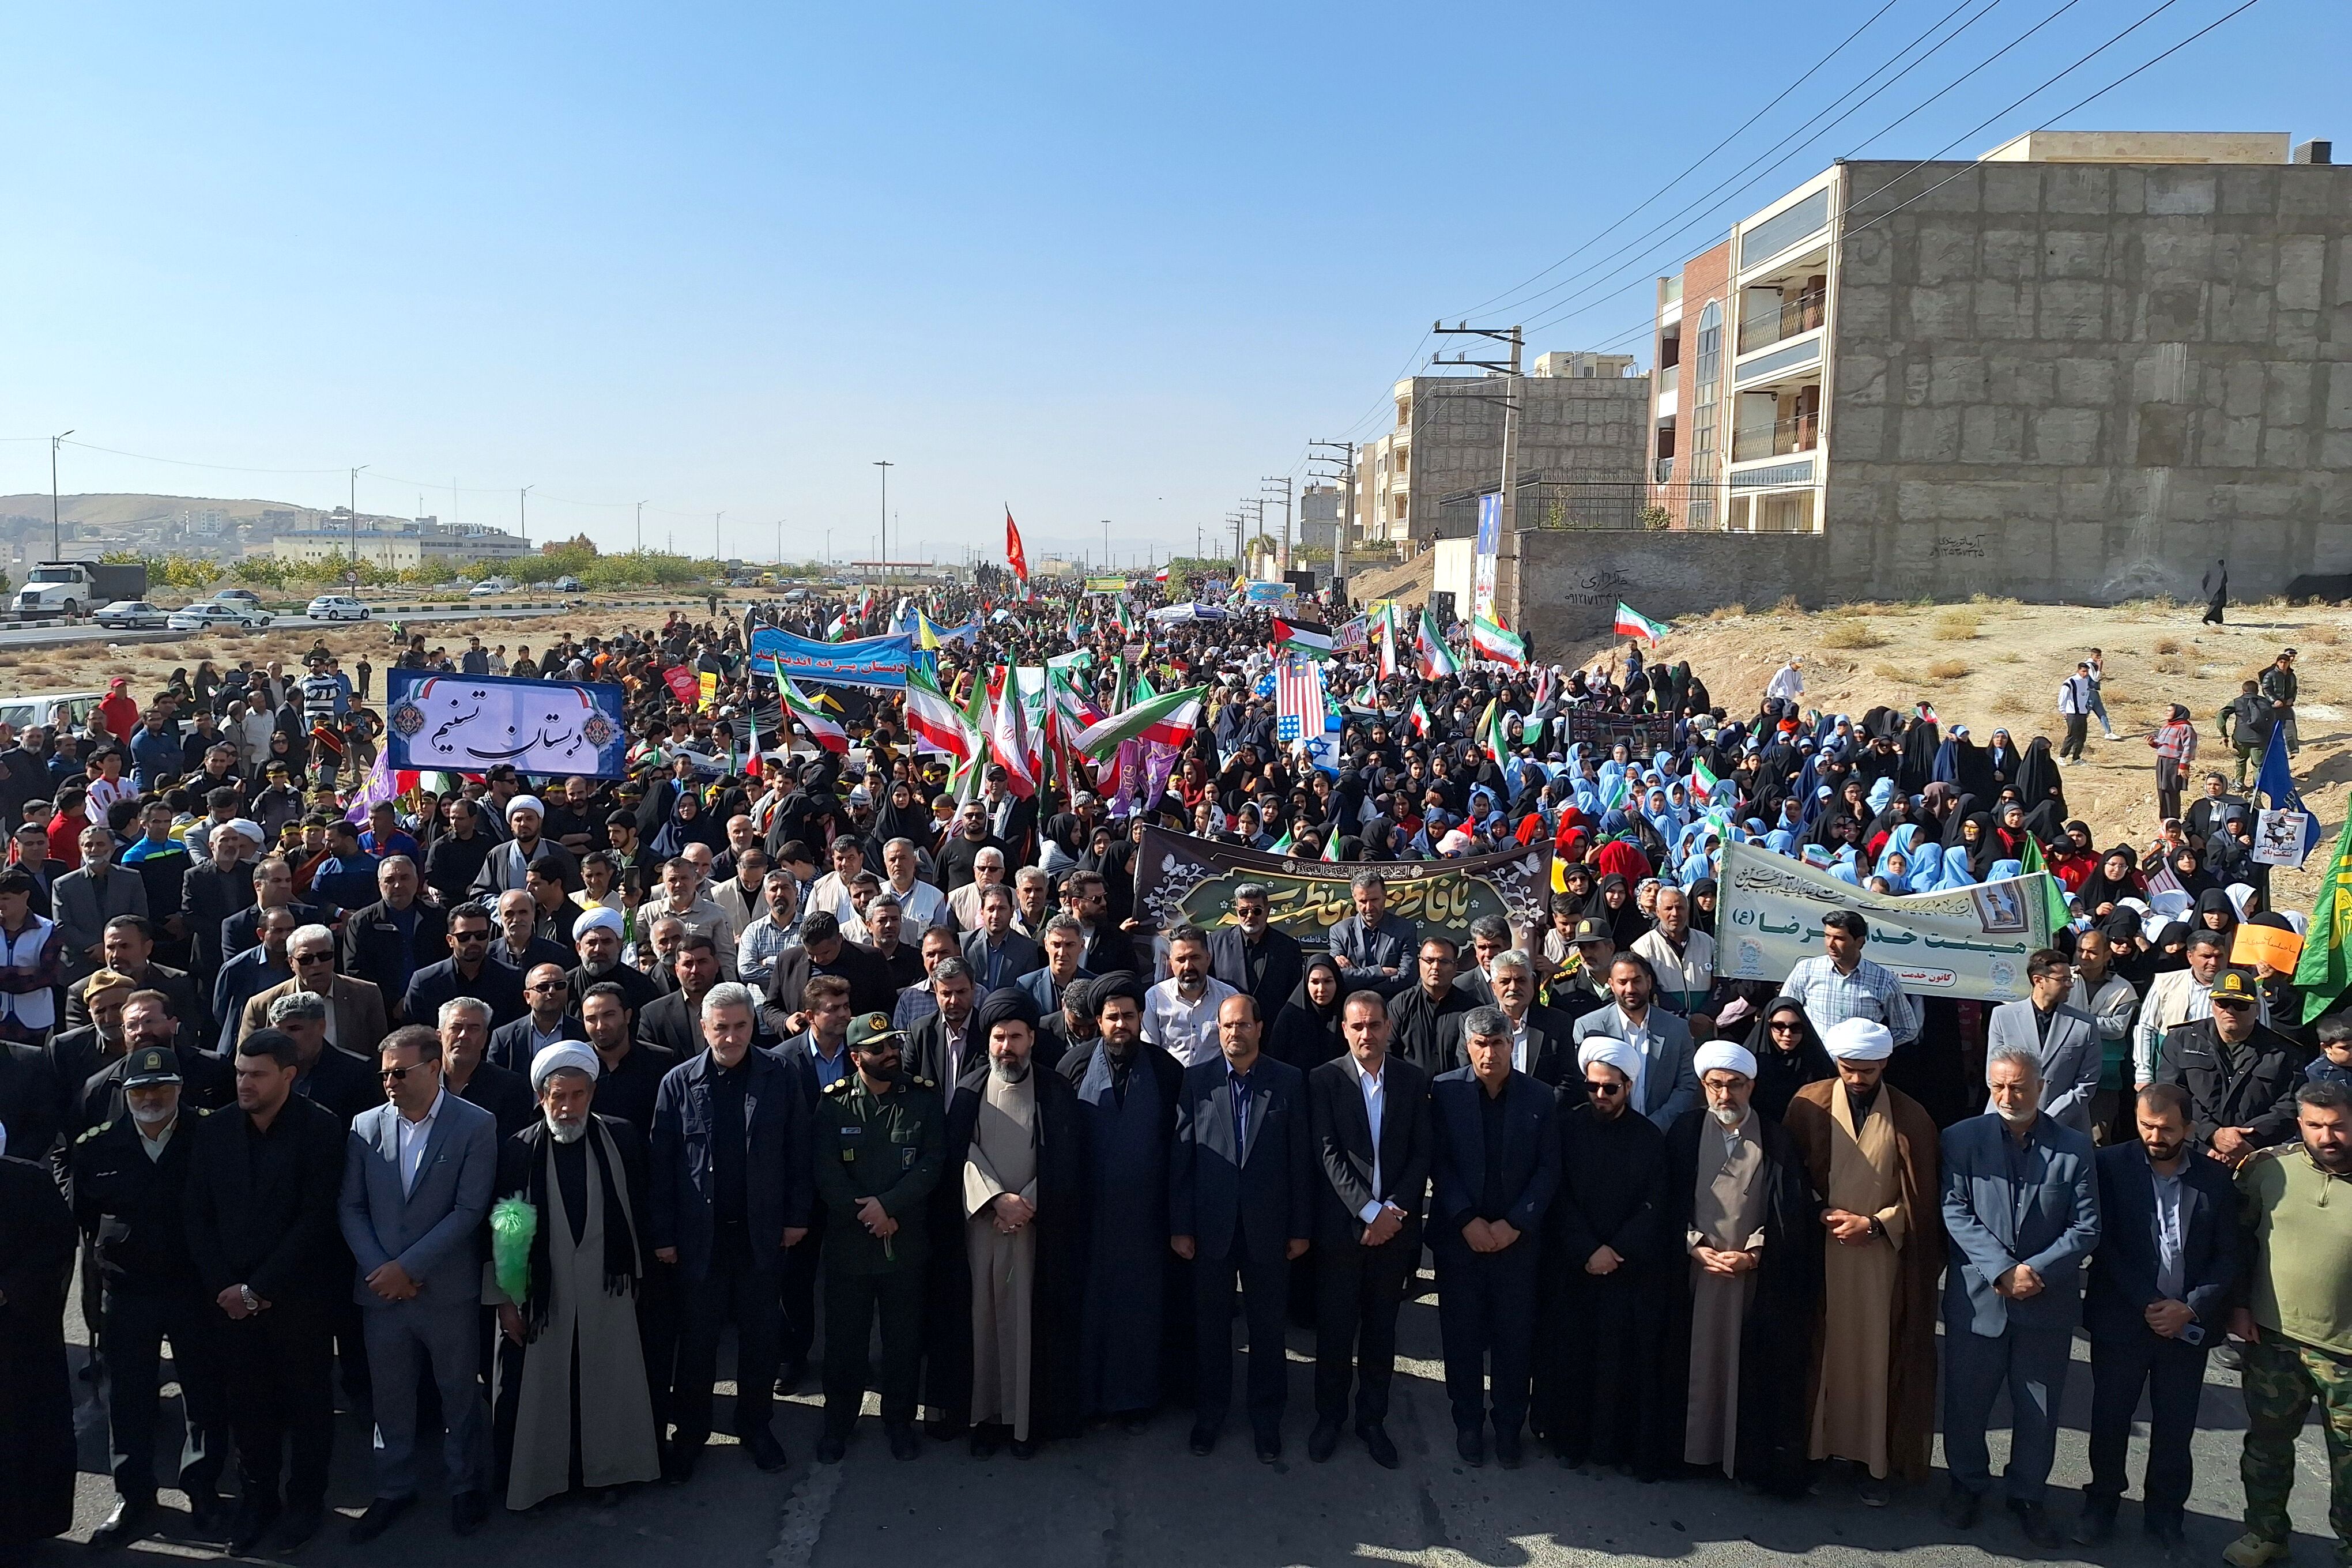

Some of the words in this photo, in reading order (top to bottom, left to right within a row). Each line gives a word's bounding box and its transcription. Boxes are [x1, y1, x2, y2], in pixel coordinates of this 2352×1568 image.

[861, 659, 907, 676] دبستان
[431, 689, 488, 753] تسنیم
[465, 713, 583, 760] دبستان
[1901, 971, 1927, 979] خدمت
[1928, 973, 1952, 983] کانون
